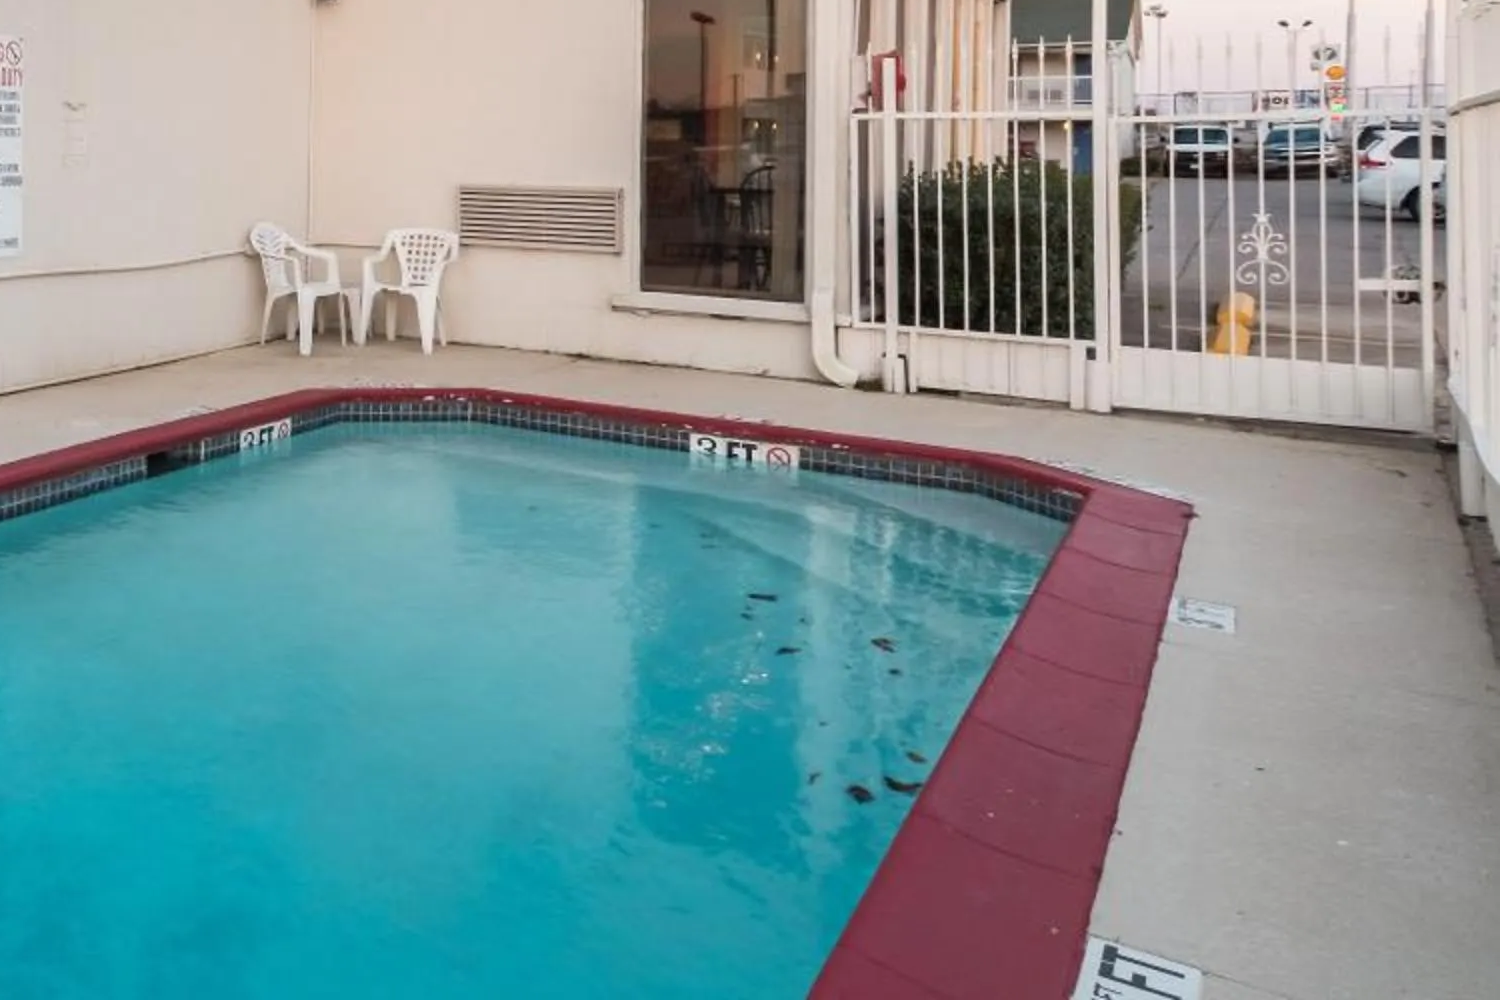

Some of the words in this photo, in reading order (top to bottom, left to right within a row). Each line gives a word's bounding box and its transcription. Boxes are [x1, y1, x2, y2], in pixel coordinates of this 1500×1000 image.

[1, 66, 22, 87] DUTY
[726, 441, 757, 462] FT
[1098, 944, 1185, 1000] FT
